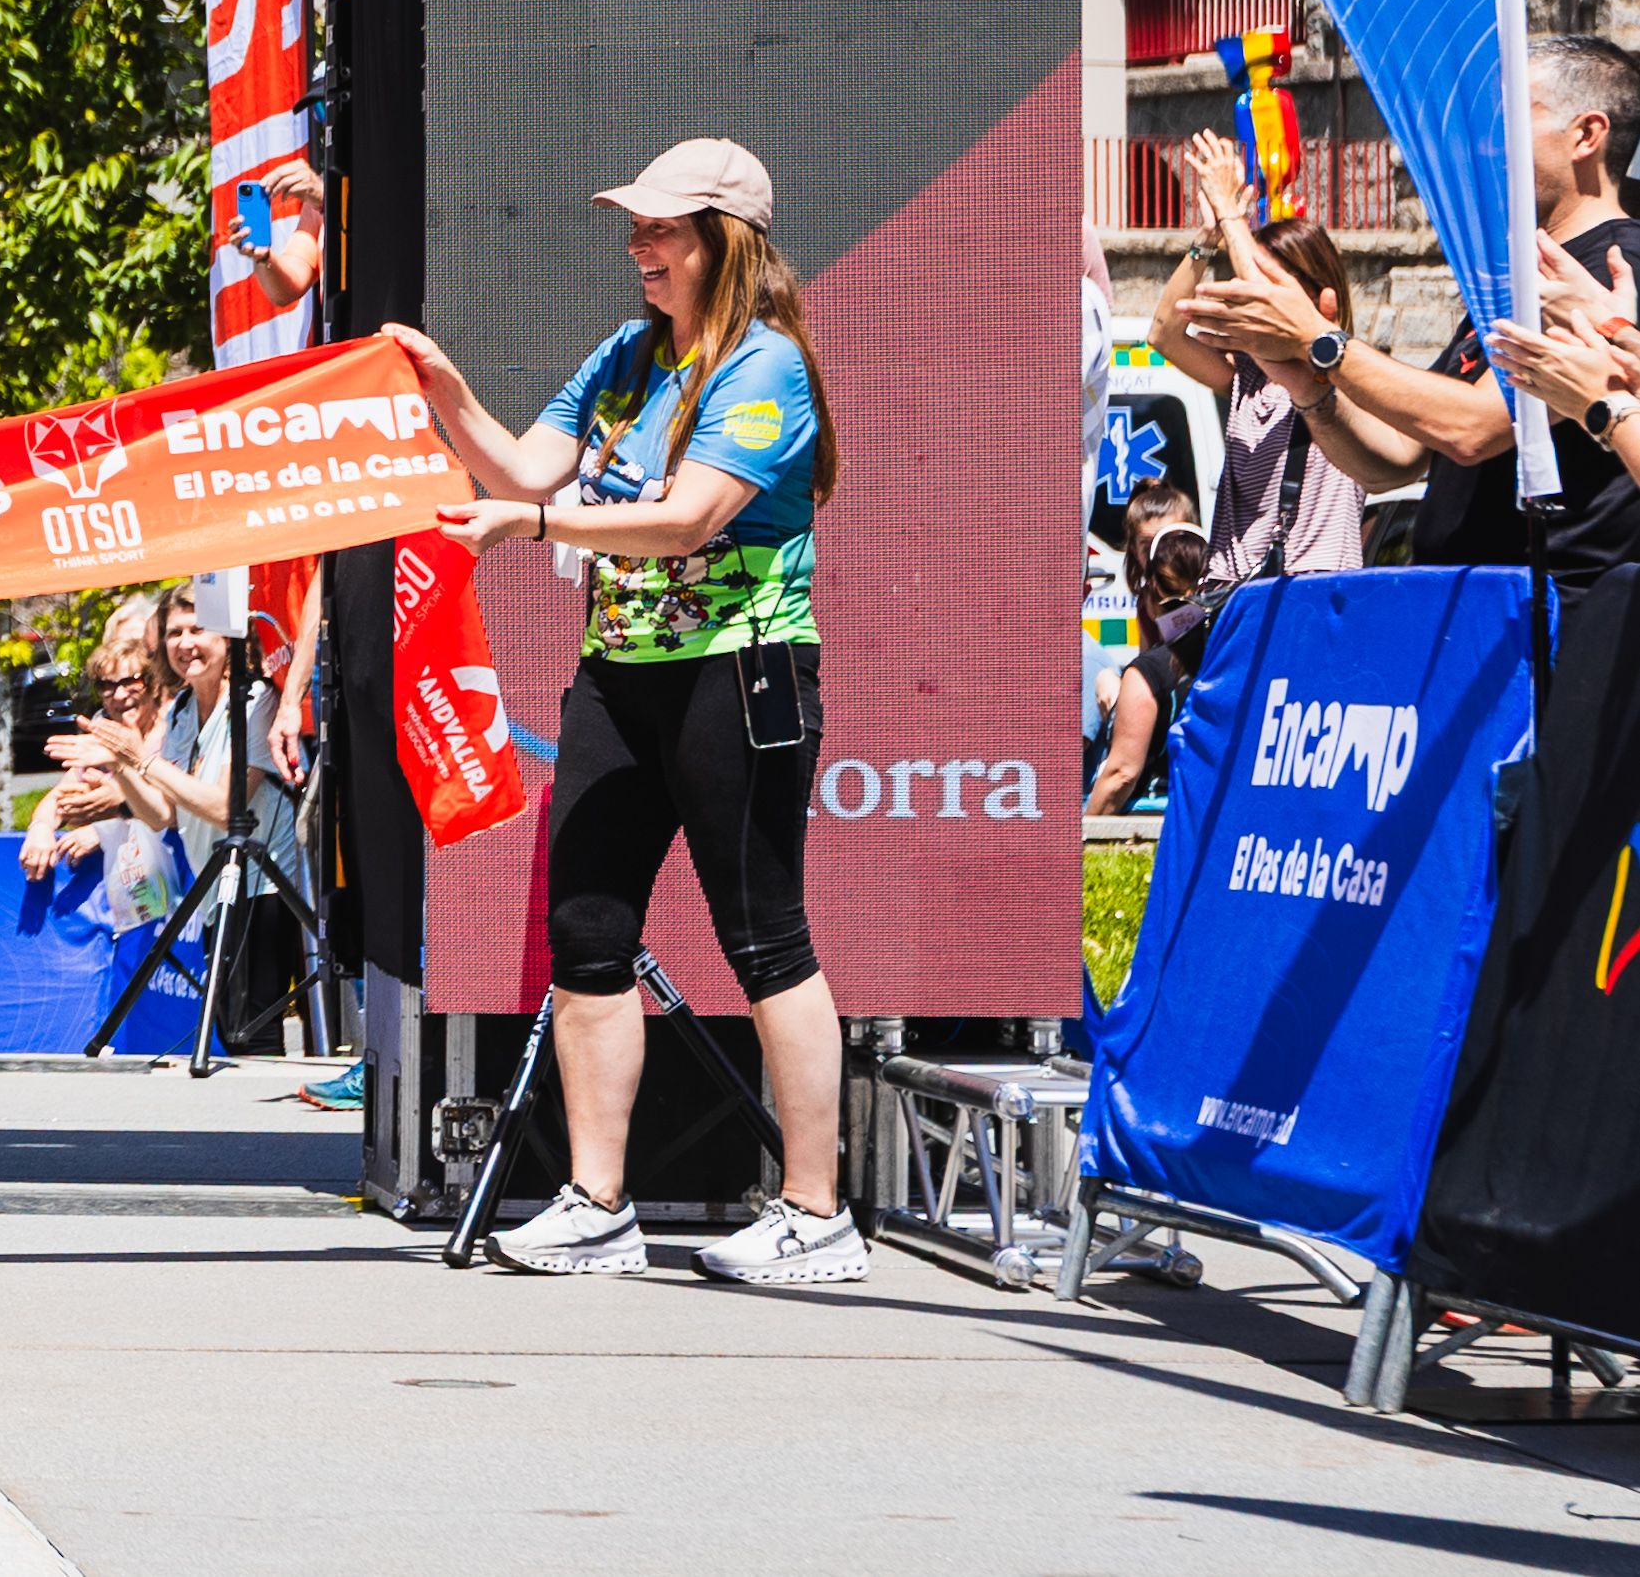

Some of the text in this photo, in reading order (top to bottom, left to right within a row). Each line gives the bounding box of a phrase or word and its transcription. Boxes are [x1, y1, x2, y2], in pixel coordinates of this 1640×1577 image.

[160, 392, 429, 455] Encamp
[172, 451, 450, 501] El Pas de la Casa
[40, 499, 144, 555] OTSO
[245, 491, 402, 529] ANDORRA
[52, 548, 145, 570] THINK SPORT
[416, 665, 494, 804] ANDVALIRA
[1250, 677, 1420, 813] Encamp
[810, 758, 1043, 820] orra
[1229, 834, 1390, 907] El Pas de la Casa
